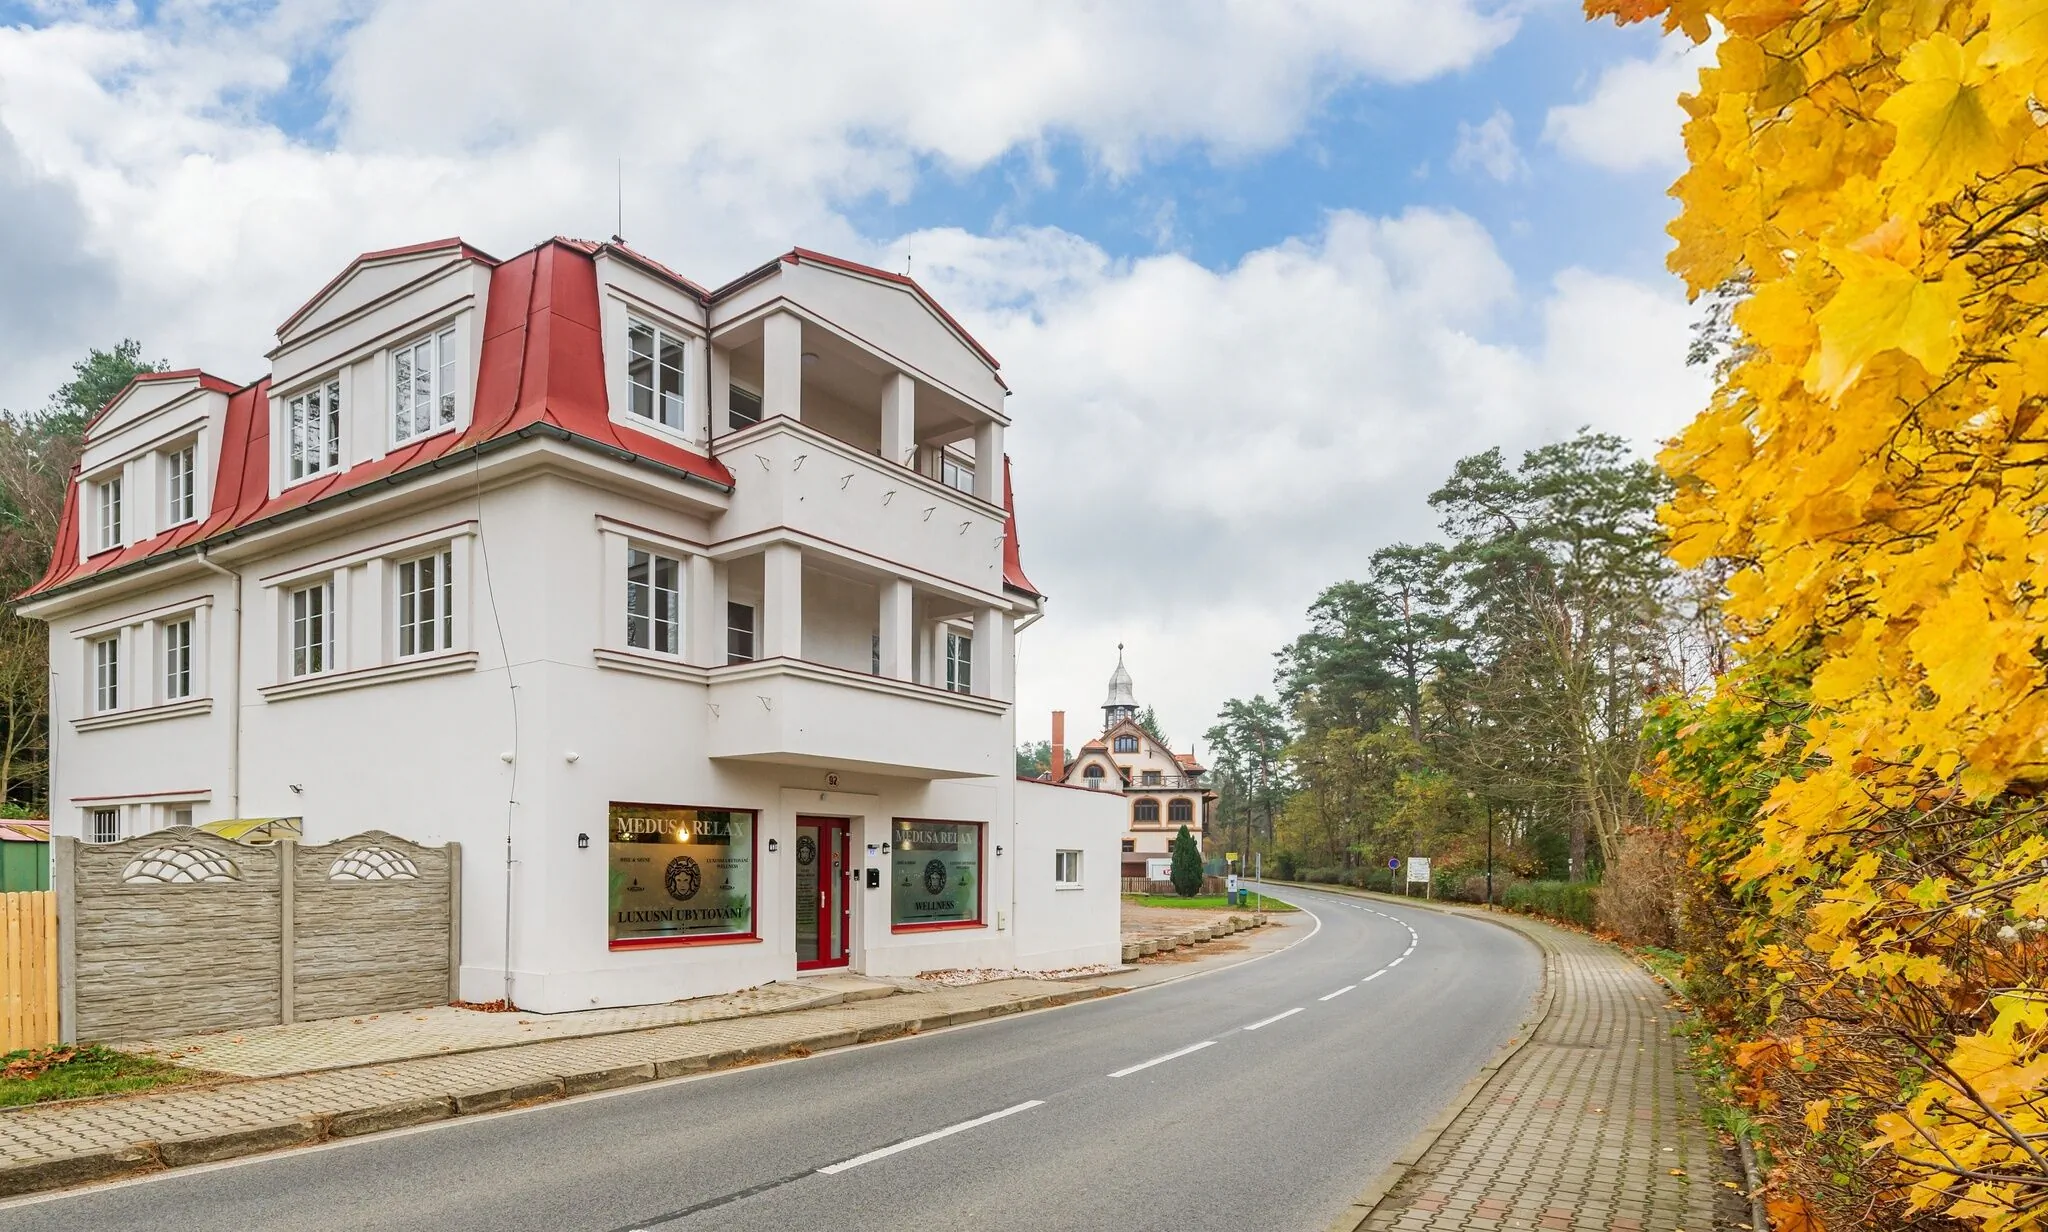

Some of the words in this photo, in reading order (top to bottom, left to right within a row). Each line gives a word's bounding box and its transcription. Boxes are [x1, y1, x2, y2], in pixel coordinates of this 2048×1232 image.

[828, 775, 838, 786] 92
[618, 817, 688, 835] MEDUSA
[693, 820, 744, 837] RELAX
[896, 829, 939, 844] MEDUSA
[941, 831, 973, 844] RELAX
[915, 900, 956, 911] WELLNESS
[618, 907, 673, 923] LUXUSNÍ
[676, 904, 743, 922] UBYTOVÁNÍ
